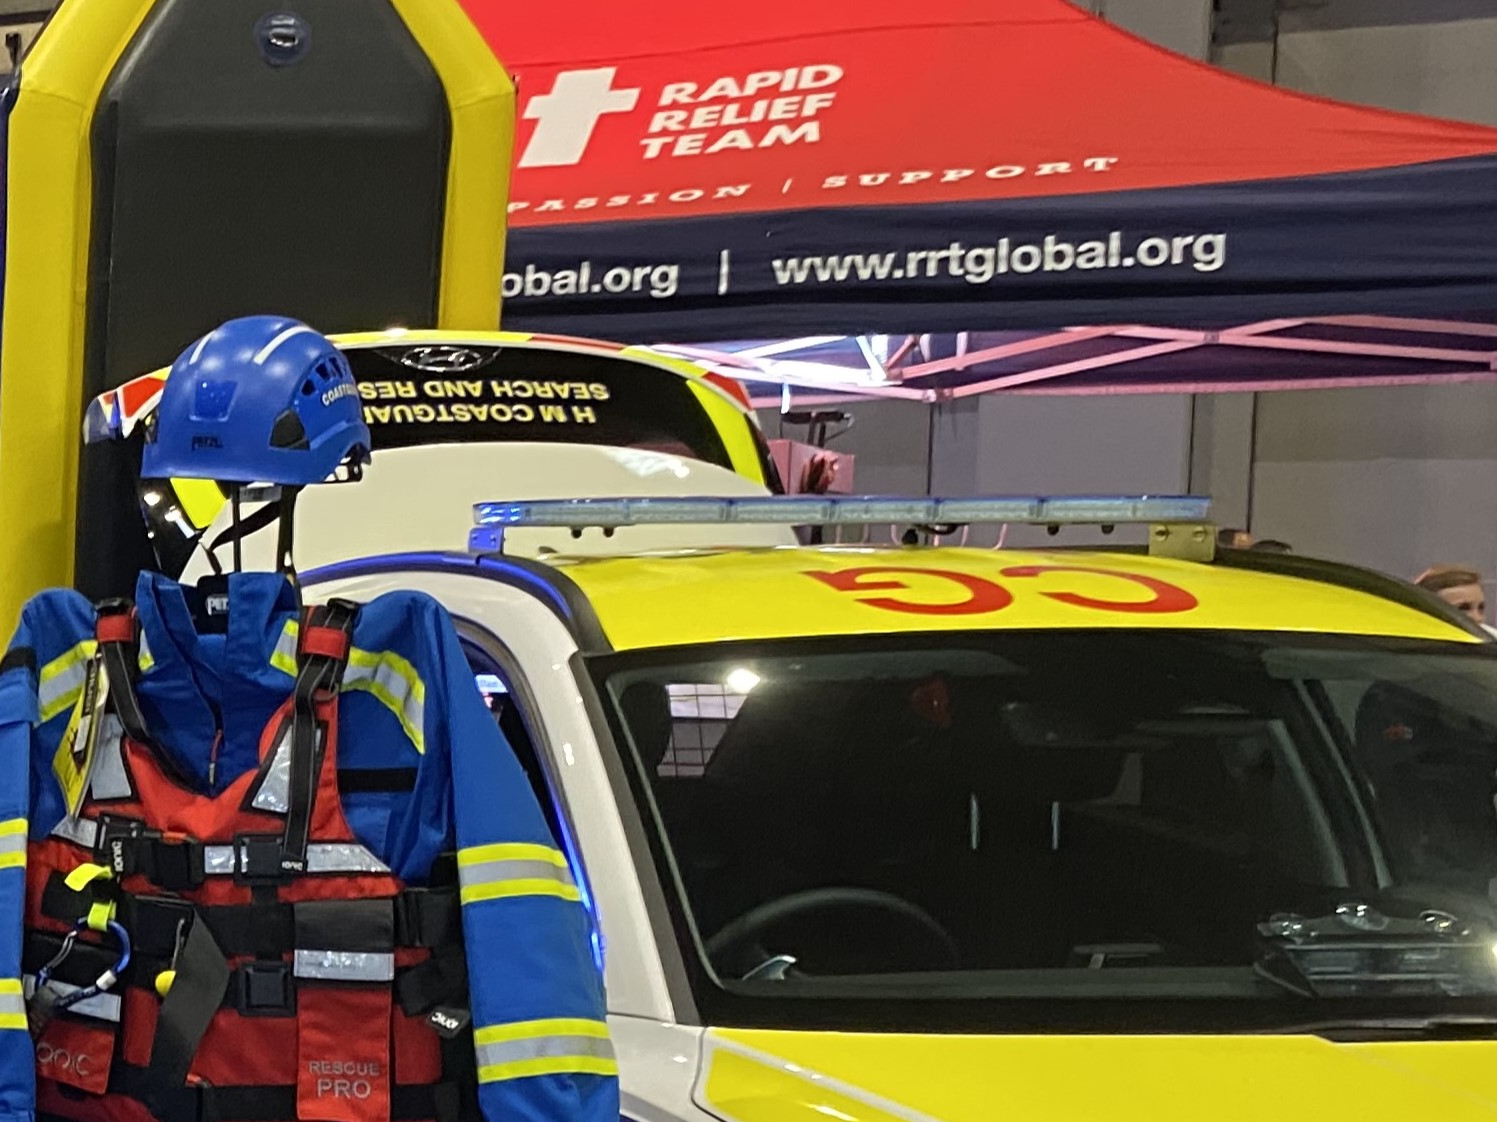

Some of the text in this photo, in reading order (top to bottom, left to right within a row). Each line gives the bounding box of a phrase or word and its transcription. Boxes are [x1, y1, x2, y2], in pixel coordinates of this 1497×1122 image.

[657, 63, 845, 107] RAPID
[647, 92, 836, 135] RELIEF
[639, 120, 822, 160] TEAM
[507, 156, 1121, 213] PASSION SUPPORT
[502, 231, 1227, 298] obal.org www.rrtglobal.org
[357, 380, 610, 400] SEARCH AND RES
[538, 405, 567, 422] M
[571, 406, 596, 423] H
[206, 596, 229, 615] PET
[309, 1061, 380, 1077] RESCUE
[317, 1078, 371, 1099] PRO
